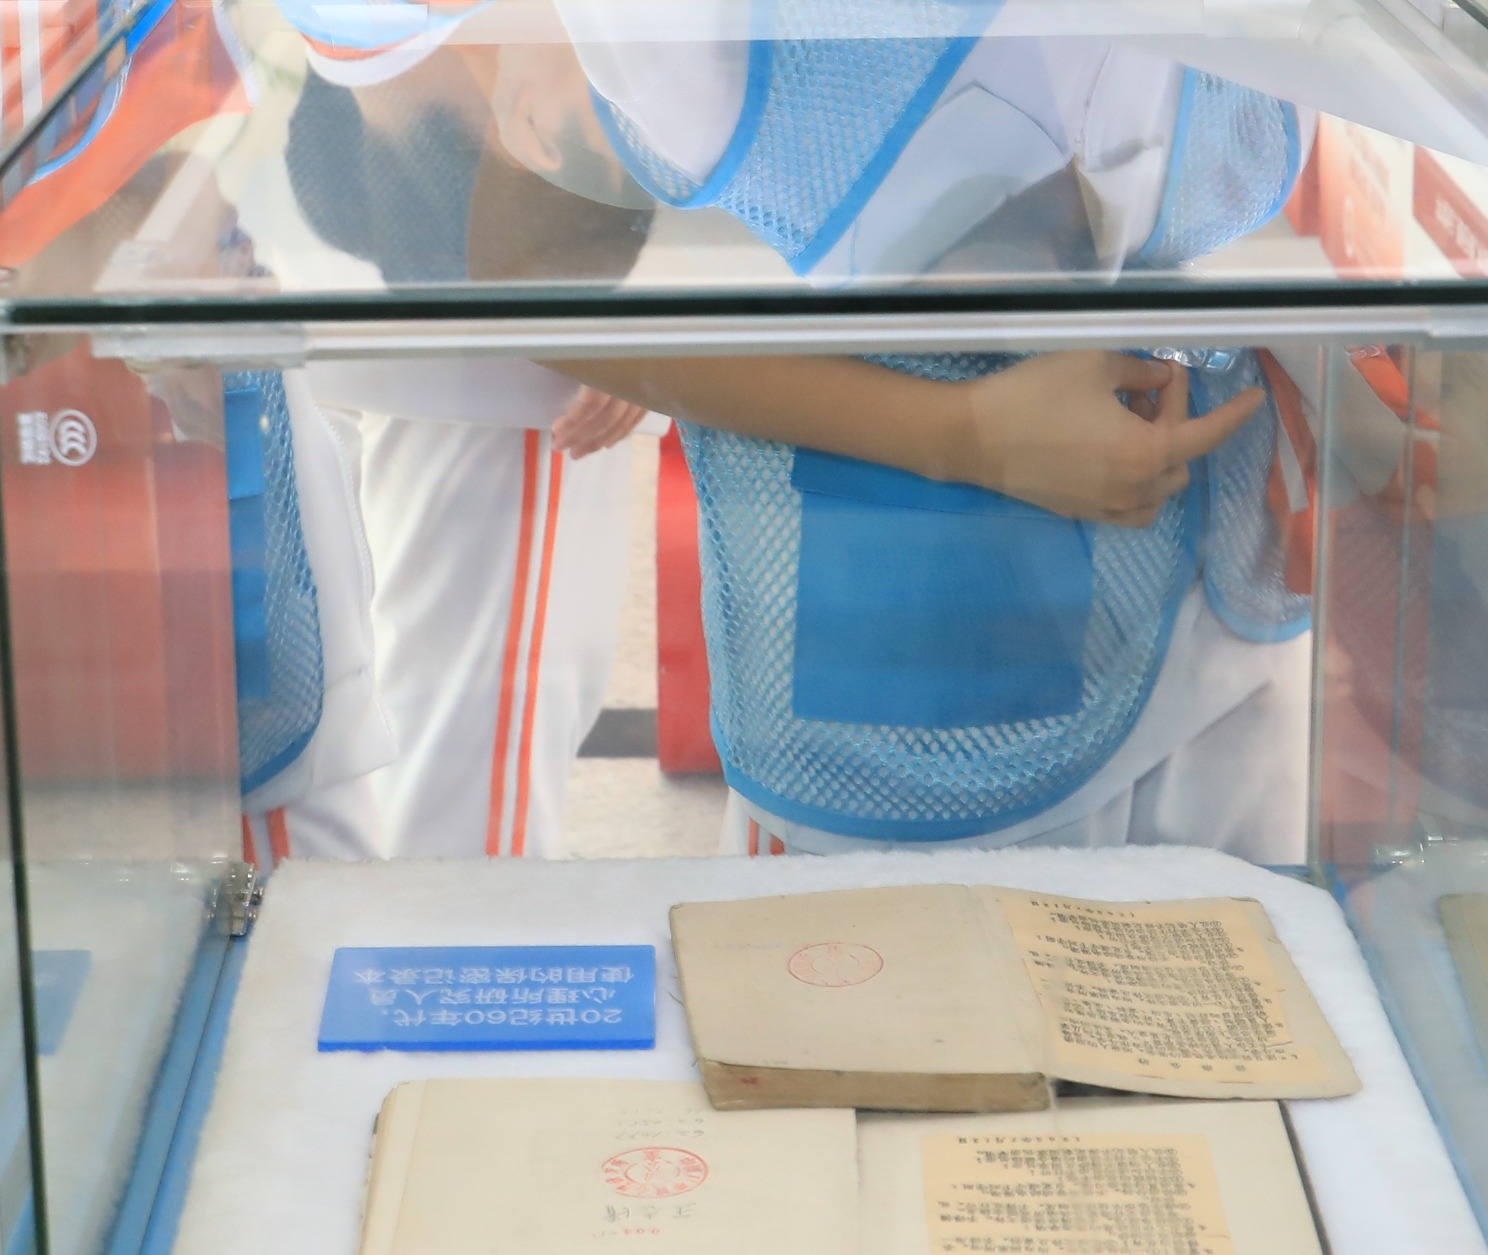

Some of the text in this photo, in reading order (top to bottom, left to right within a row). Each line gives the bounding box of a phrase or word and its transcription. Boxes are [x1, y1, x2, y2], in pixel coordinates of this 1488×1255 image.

[353, 966, 634, 986] 使用的保密记录本
[369, 986, 616, 1006] 心理所研究人员
